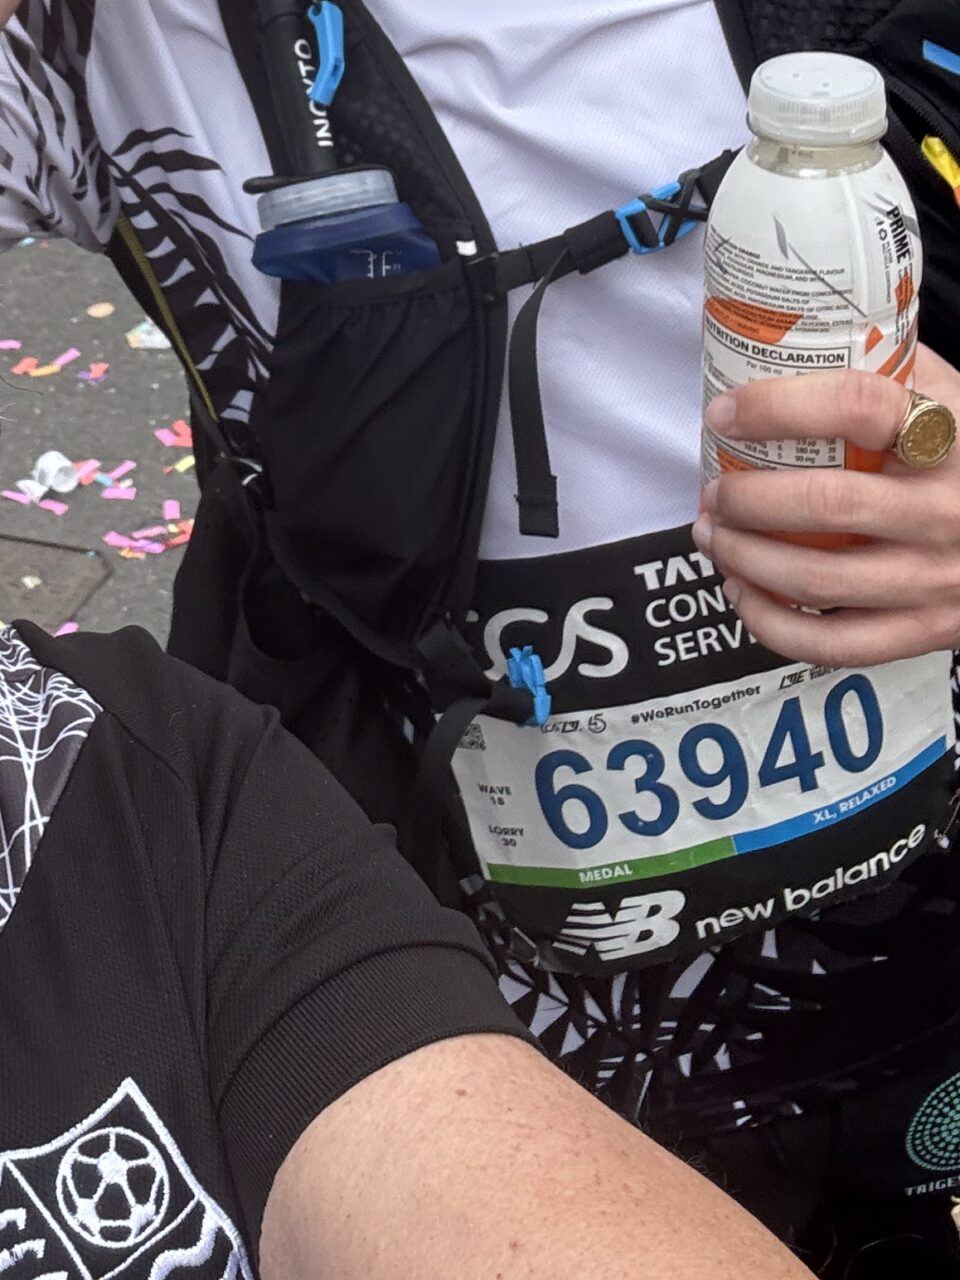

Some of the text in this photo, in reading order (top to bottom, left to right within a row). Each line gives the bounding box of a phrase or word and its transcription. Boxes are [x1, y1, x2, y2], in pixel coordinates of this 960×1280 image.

[886, 205, 911, 265] PRIME
[771, 264, 784, 272] AND
[746, 360, 757, 369] Per
[759, 364, 771, 374] 100
[752, 345, 845, 364] DECLARATION
[634, 551, 715, 591] TAT
[645, 585, 735, 628] CON
[467, 597, 629, 682] CS
[630, 684, 761, 725] #WeRunTogether
[535, 673, 884, 849] 63940
[478, 783, 513, 796] WAVE
[840, 775, 897, 815] RELAXED
[489, 824, 525, 837] LORRY
[578, 863, 633, 884] MEDAL
[695, 897, 775, 940] new
[783, 823, 927, 912] balance
[904, 1175, 960, 1197] TRIGE
